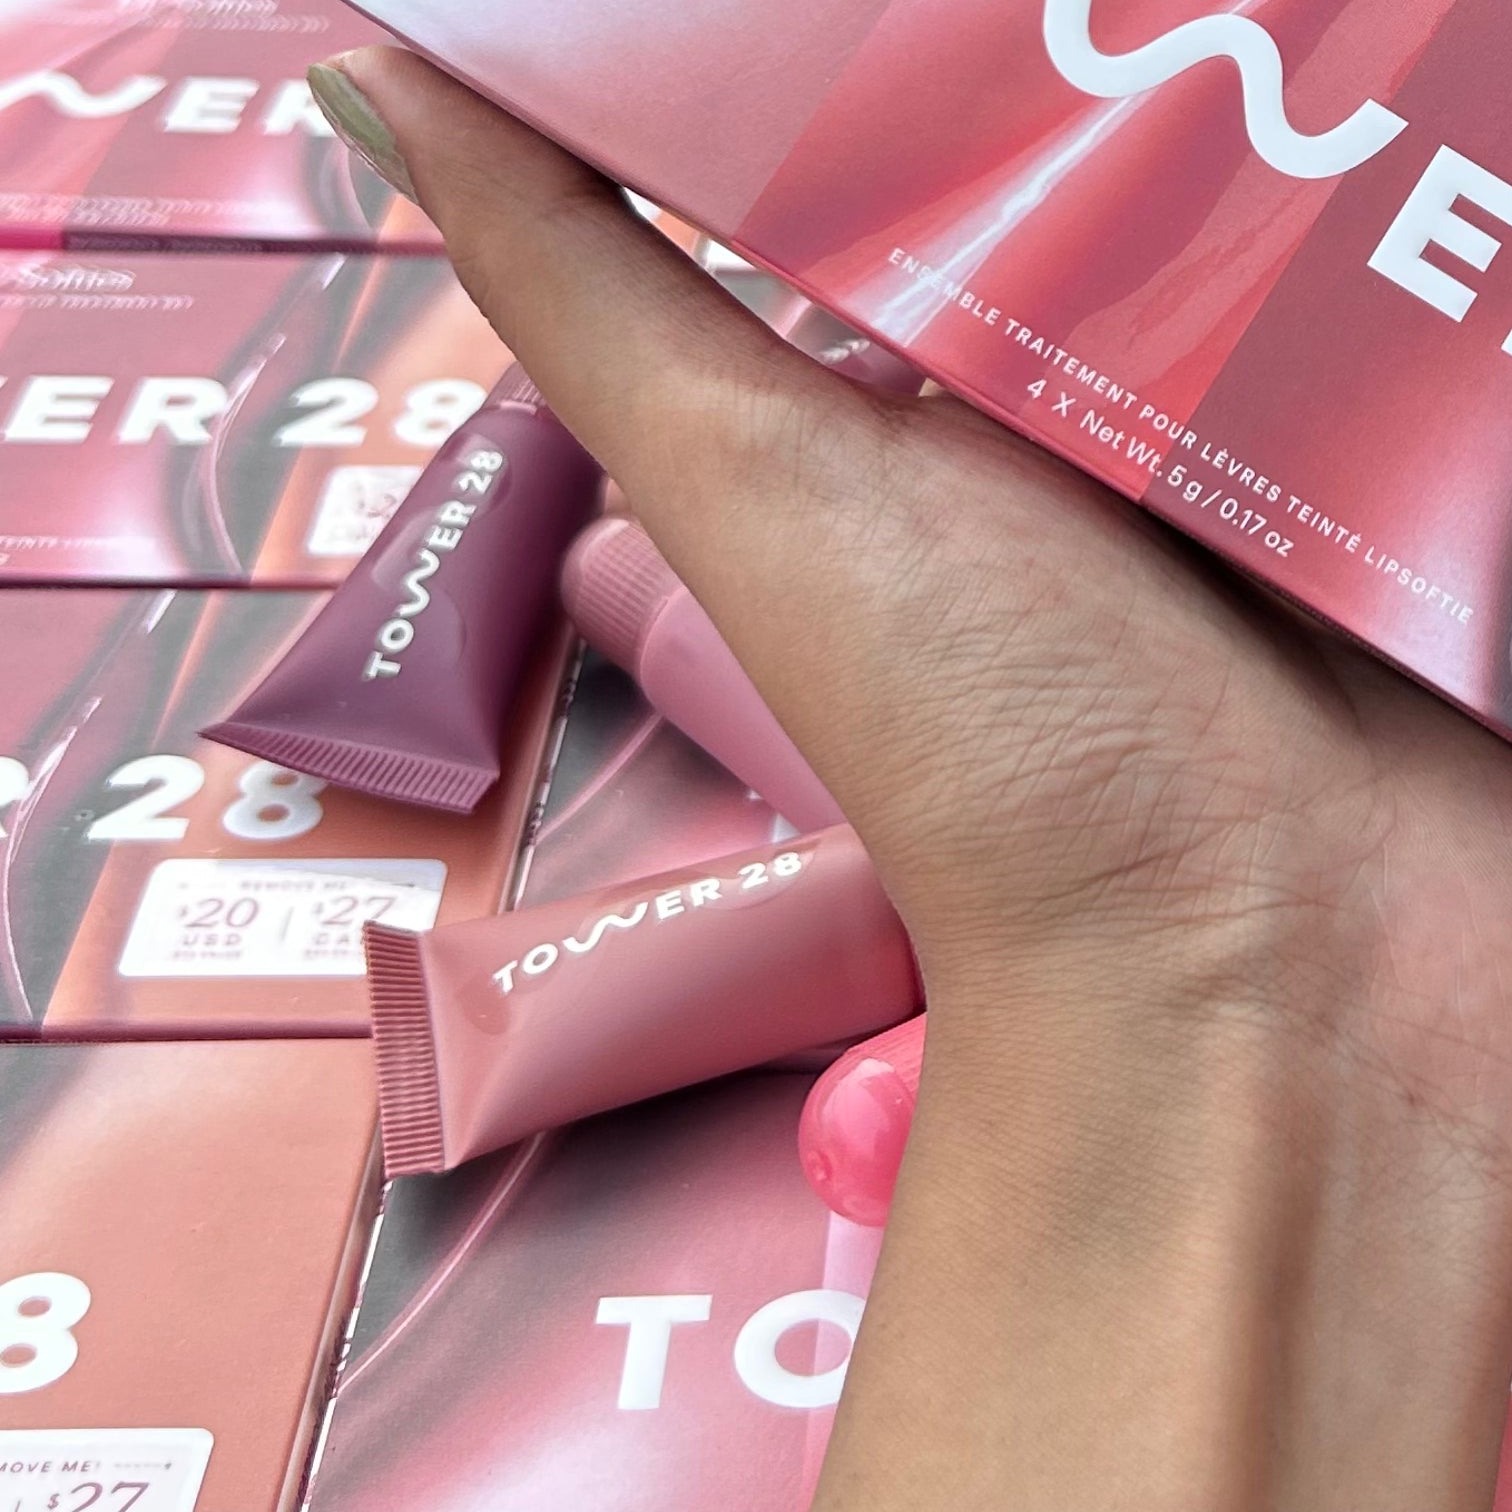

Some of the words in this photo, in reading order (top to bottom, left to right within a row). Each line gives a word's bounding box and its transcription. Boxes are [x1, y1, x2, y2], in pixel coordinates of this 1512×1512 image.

[0, 374, 229, 445] ER
[273, 376, 487, 449] 28
[889, 248, 1001, 325] ENSEMBLE
[1004, 318, 1138, 410] TRAITEMENT
[1138, 404, 1198, 450] POUR
[1286, 494, 1362, 553] TEINTÉ
[1364, 545, 1474, 625] LIPSOFTIE
[1026, 378, 1047, 399] 4
[1080, 410, 1126, 451] Net
[1125, 437, 1163, 477] Wt.
[1220, 497, 1268, 535] 0.17
[1264, 531, 1295, 558] oz
[364, 500, 477, 681] TOWER
[458, 450, 504, 495] 28
[85, 754, 325, 842] 28
[178, 896, 260, 928] $20
[312, 895, 398, 926] $27
[182, 934, 242, 946] USD
[492, 878, 722, 995] TOWER
[738, 852, 803, 889] 28
[0, 1271, 92, 1394] 8
[595, 1288, 869, 1409] TO
[47, 1481, 150, 1512] $27
